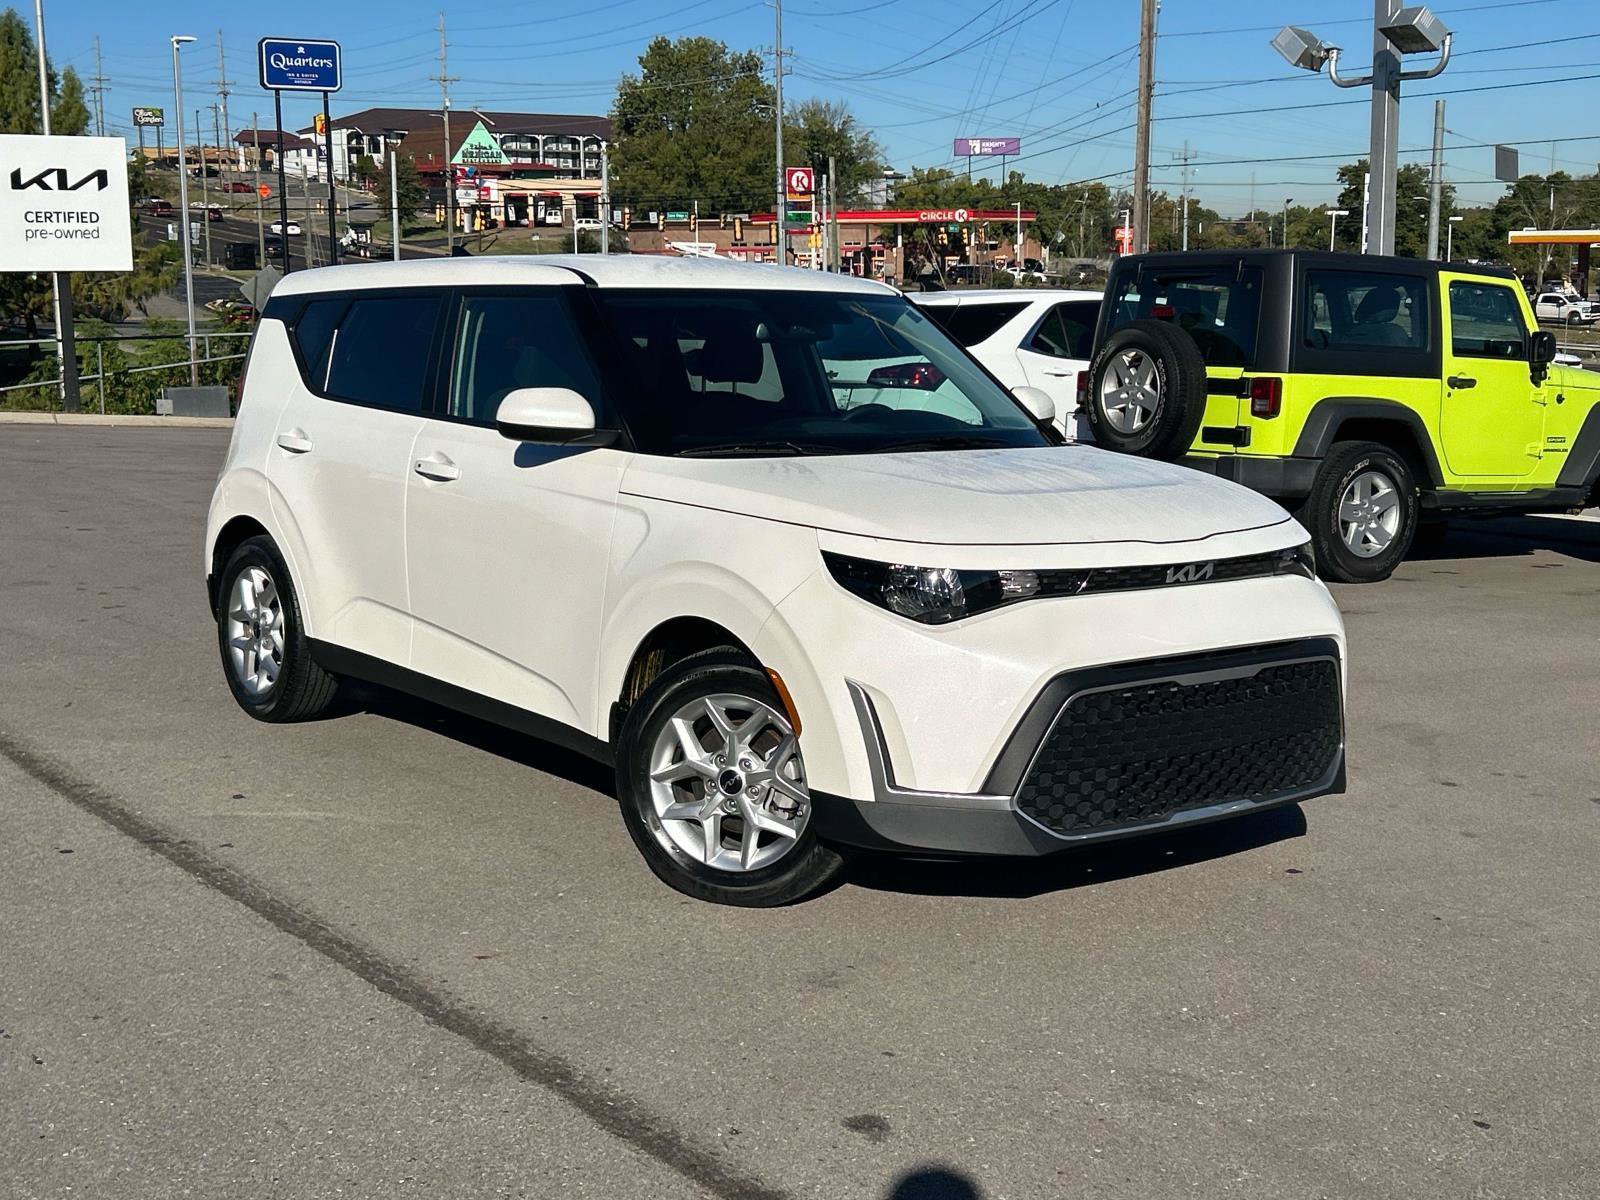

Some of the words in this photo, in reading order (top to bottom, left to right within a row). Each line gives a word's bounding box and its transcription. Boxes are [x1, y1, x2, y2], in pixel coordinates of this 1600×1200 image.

[270, 53, 333, 71] Quarters
[137, 116, 163, 125] Garden
[10, 167, 108, 192] KIA
[795, 175, 807, 191] K
[24, 211, 100, 224] CERTIFIED
[920, 210, 954, 221] CIRCLE
[25, 226, 100, 242] pre-owned
[1165, 562, 1214, 583] KIA
